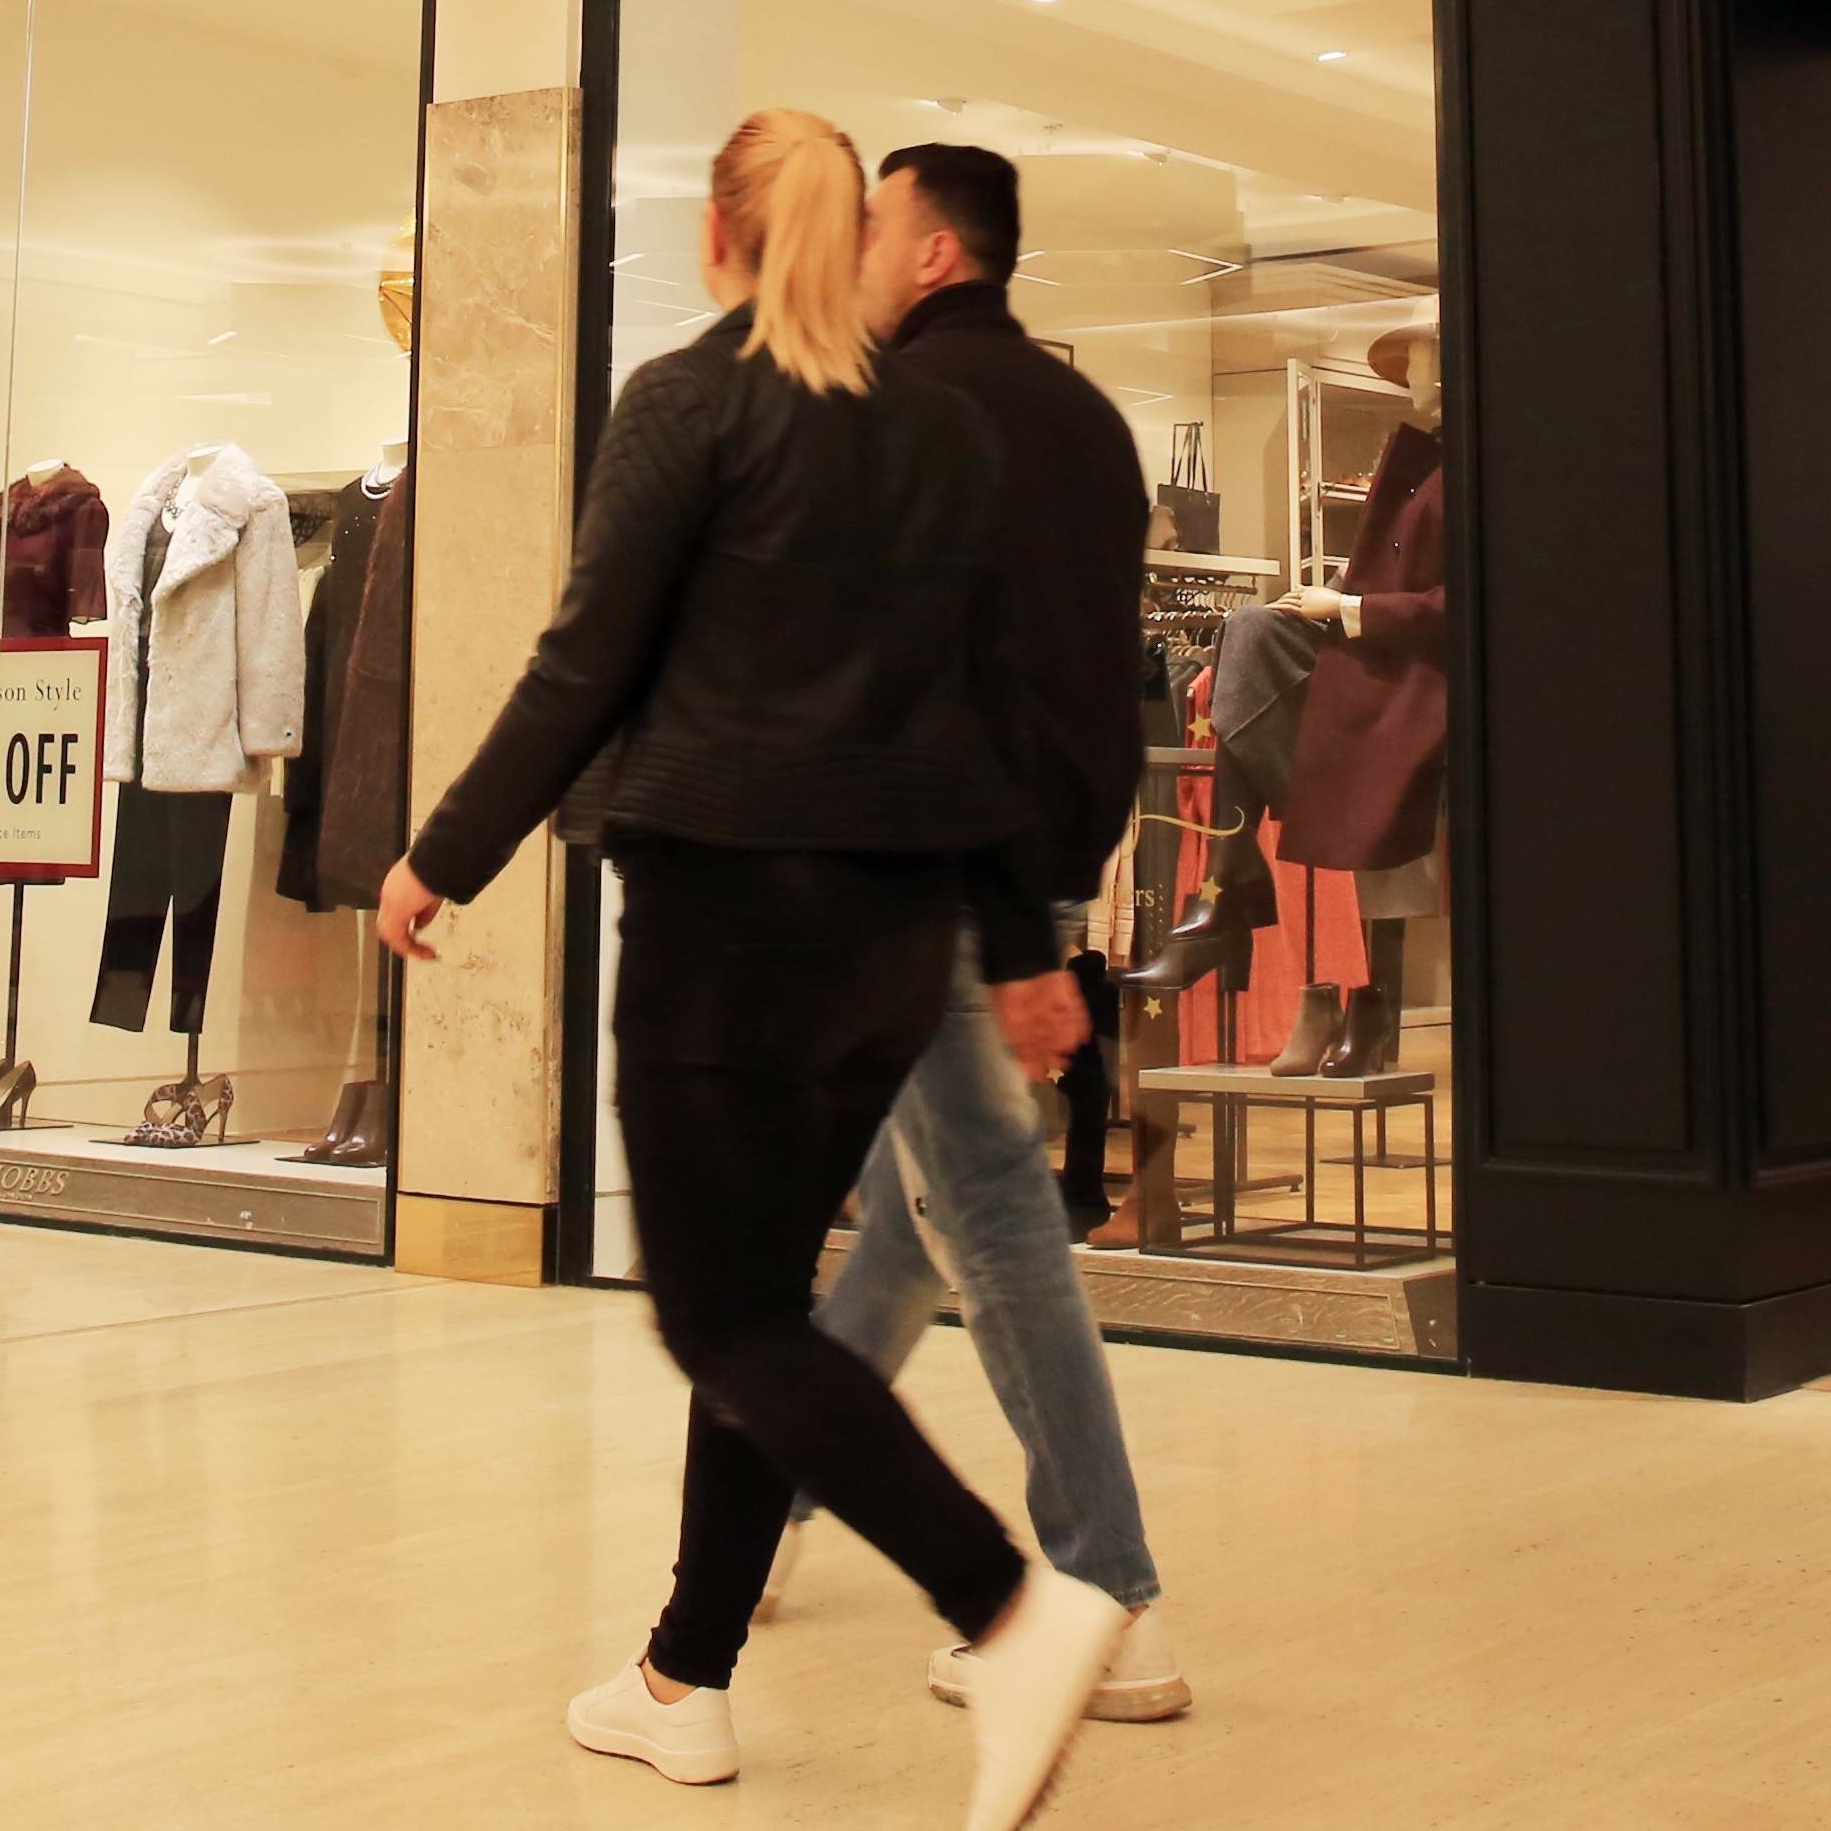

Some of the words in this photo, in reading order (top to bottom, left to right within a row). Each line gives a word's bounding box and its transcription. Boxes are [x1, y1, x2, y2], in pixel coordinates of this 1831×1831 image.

[35, 677, 82, 711] Style
[5, 732, 79, 805] OFF
[13, 826, 41, 839] Items
